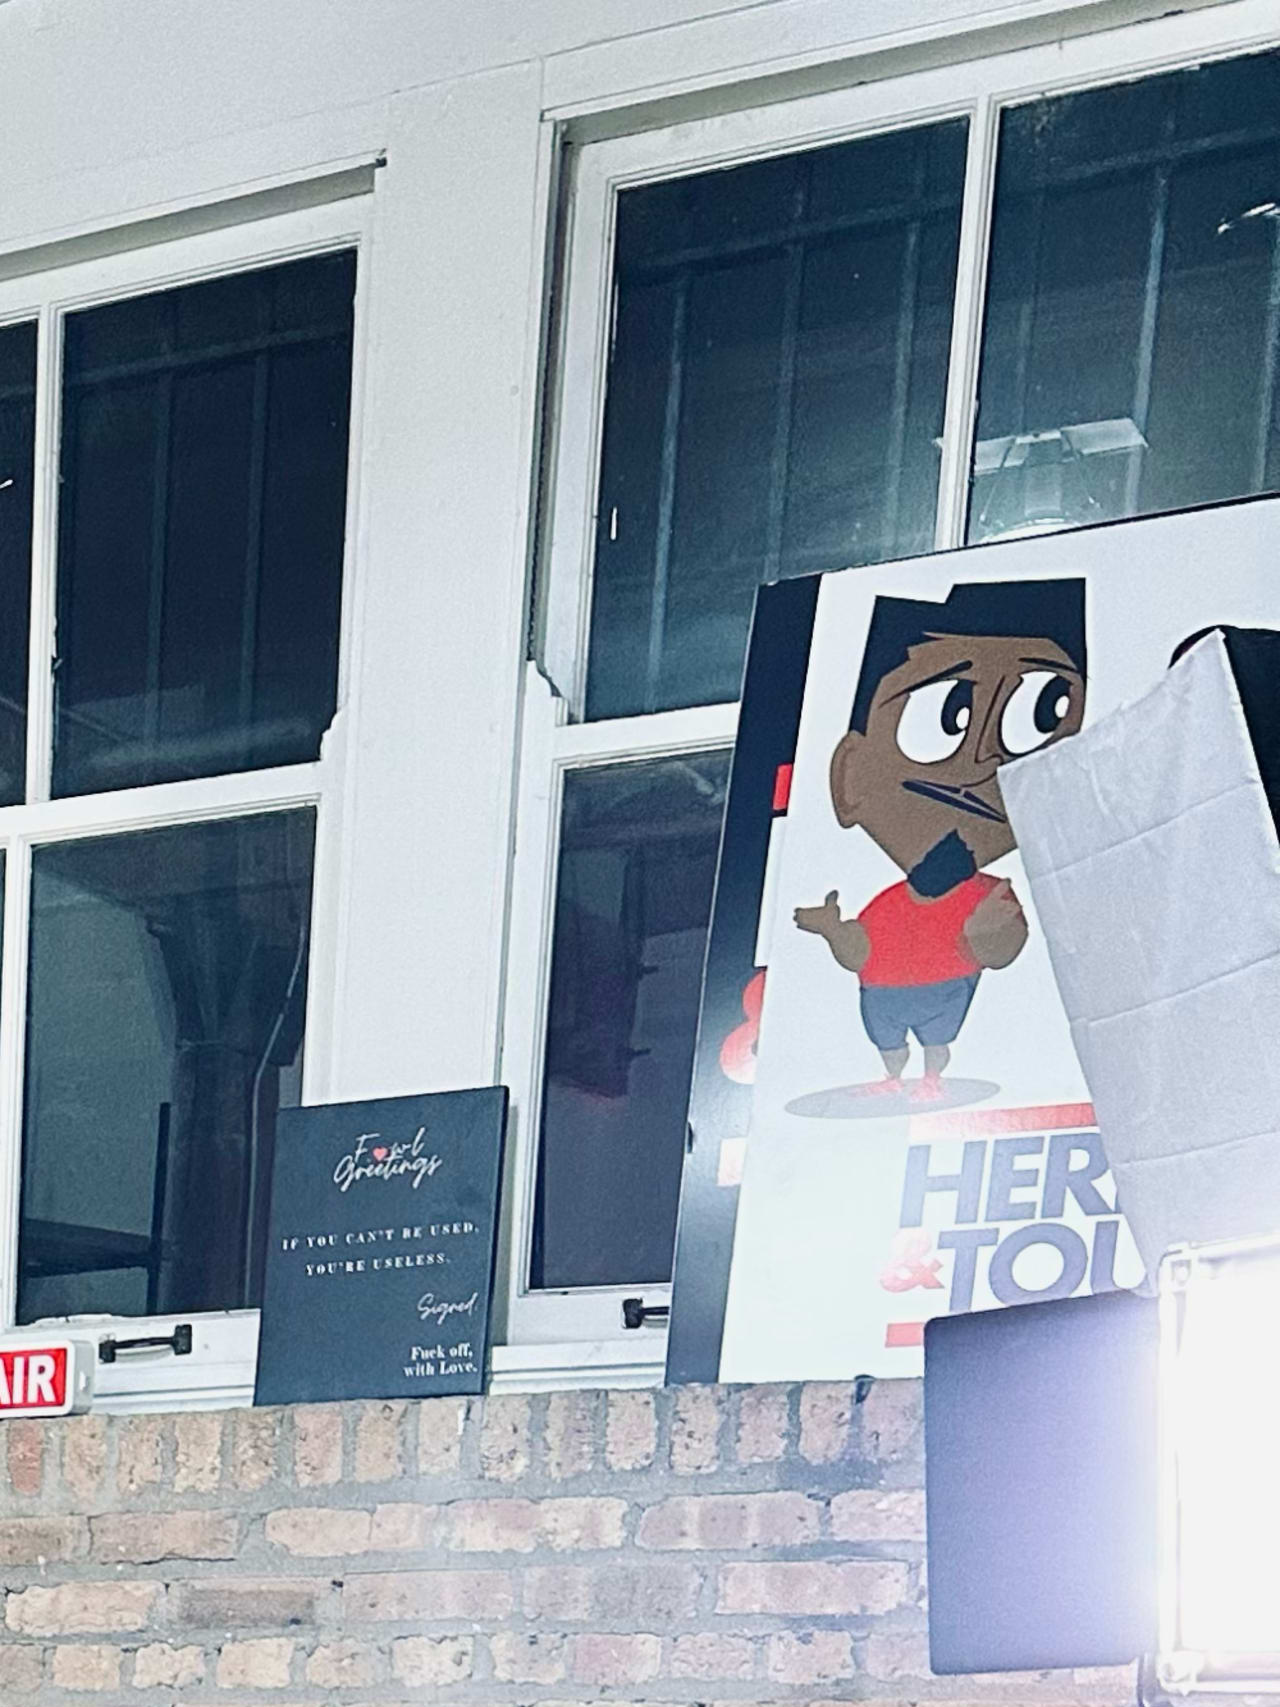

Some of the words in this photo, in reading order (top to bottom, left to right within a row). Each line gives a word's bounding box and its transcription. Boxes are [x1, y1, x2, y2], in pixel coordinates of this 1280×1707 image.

[333, 1154, 443, 1193] Greetings
[900, 1132, 1122, 1229] HER
[282, 1238, 299, 1251] IF
[307, 1234, 338, 1248] YOU
[346, 1229, 395, 1245] CAN'T
[402, 1226, 422, 1240] BE
[306, 1259, 366, 1277] YOU'RE
[411, 1344, 445, 1361] Fuck
[403, 1362, 435, 1377] with
[440, 1361, 478, 1375] Love.
